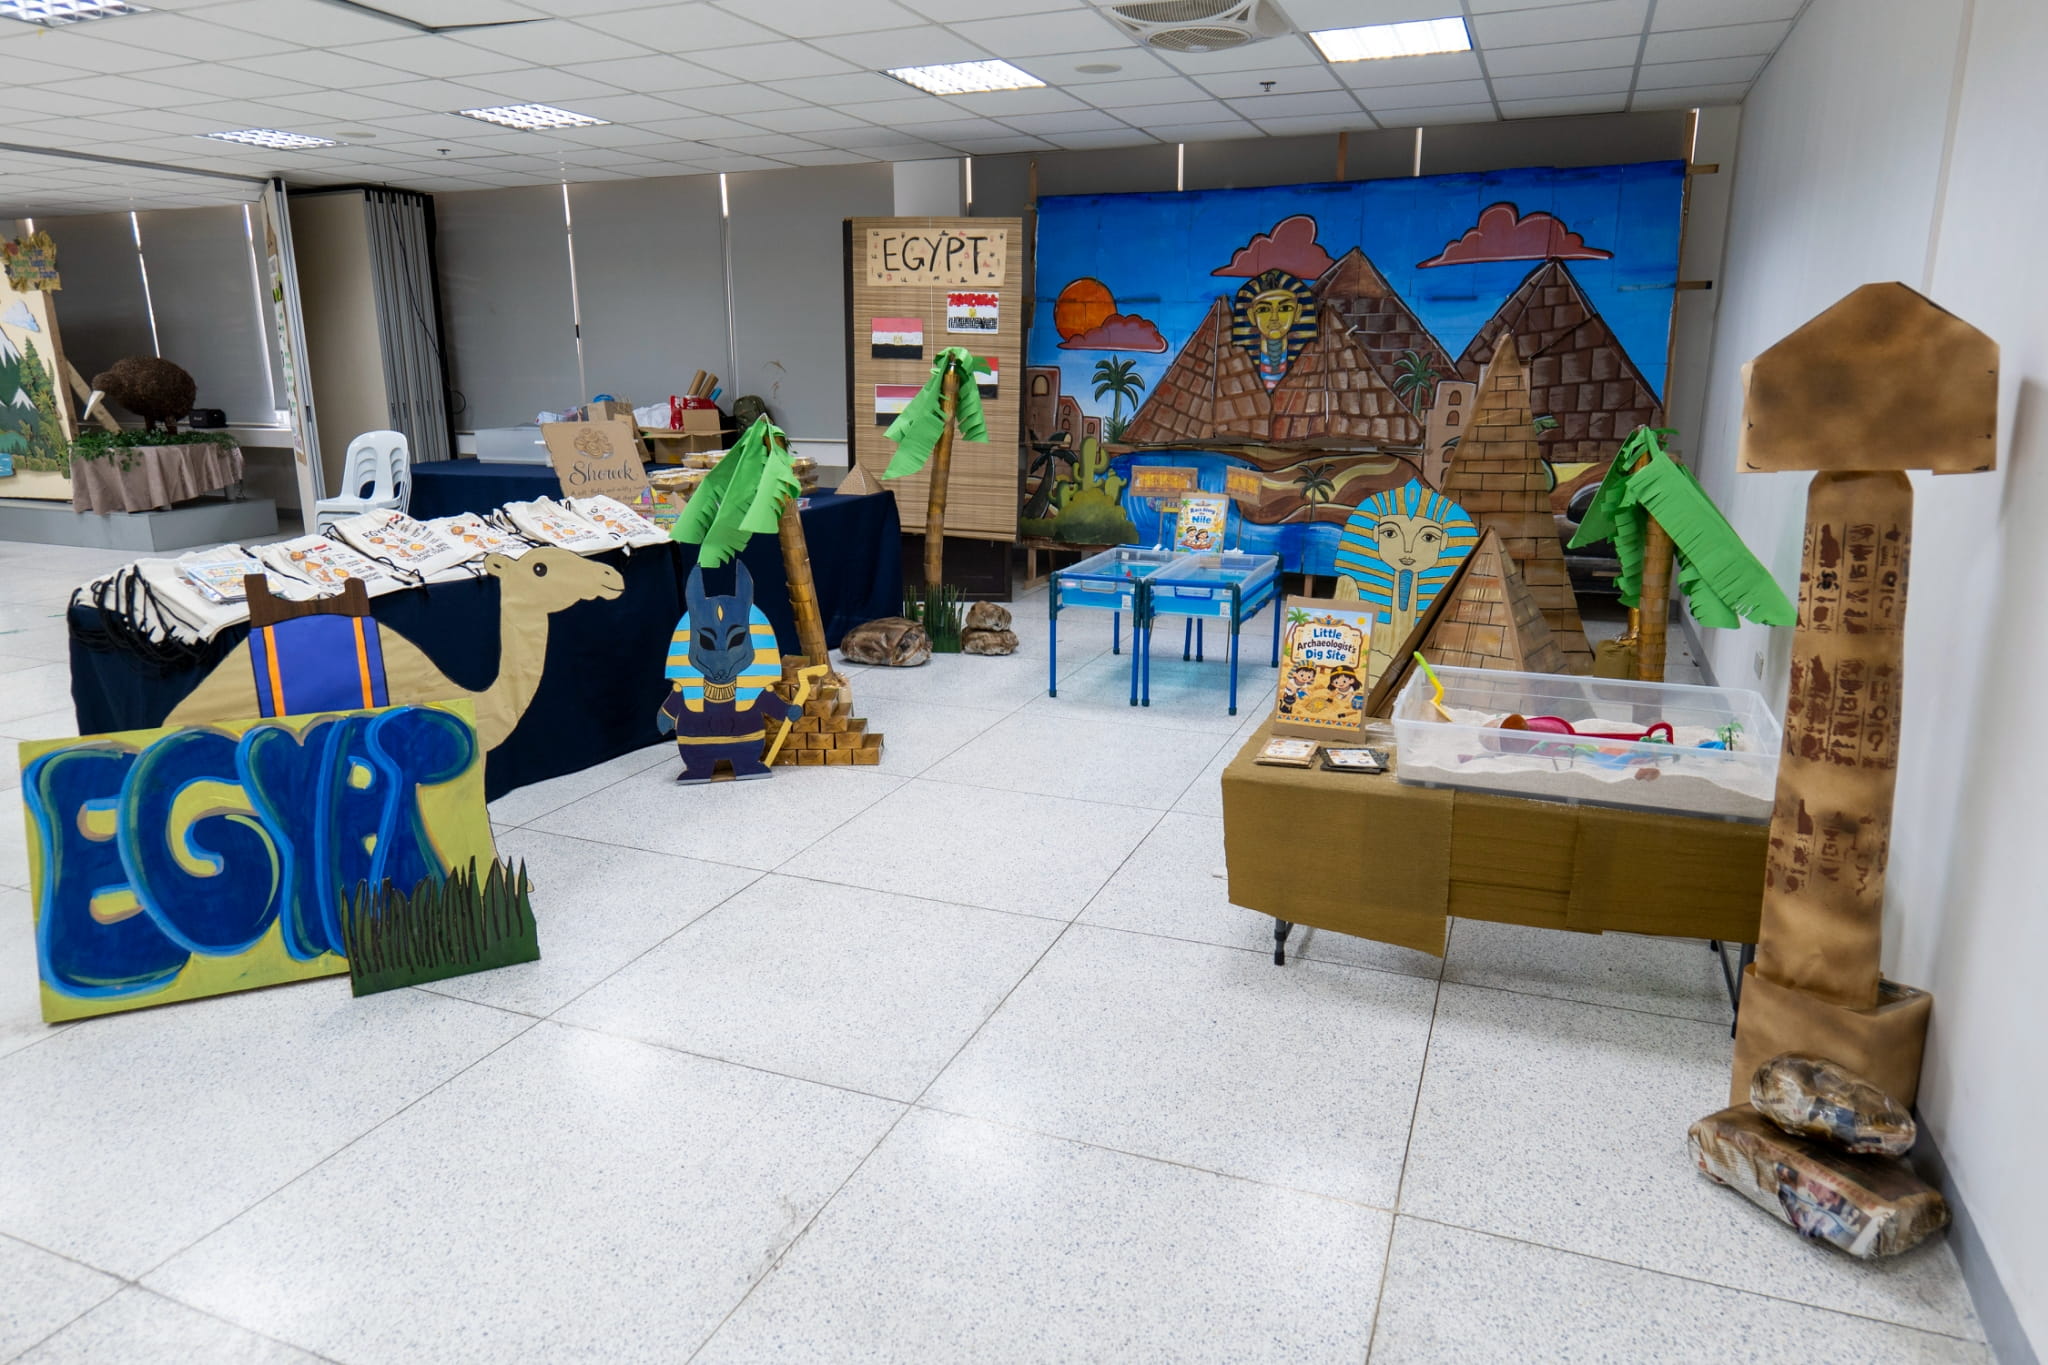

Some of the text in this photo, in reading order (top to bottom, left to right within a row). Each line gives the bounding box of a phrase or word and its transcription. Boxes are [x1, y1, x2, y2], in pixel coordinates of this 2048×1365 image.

[883, 237, 987, 274] EGYPT
[1191, 515, 1212, 524] Nile
[1313, 628, 1342, 639] Little
[1297, 638, 1357, 653] Archaeologist's
[1305, 649, 1346, 661] Dig Site
[21, 704, 480, 1001] EGYPT
